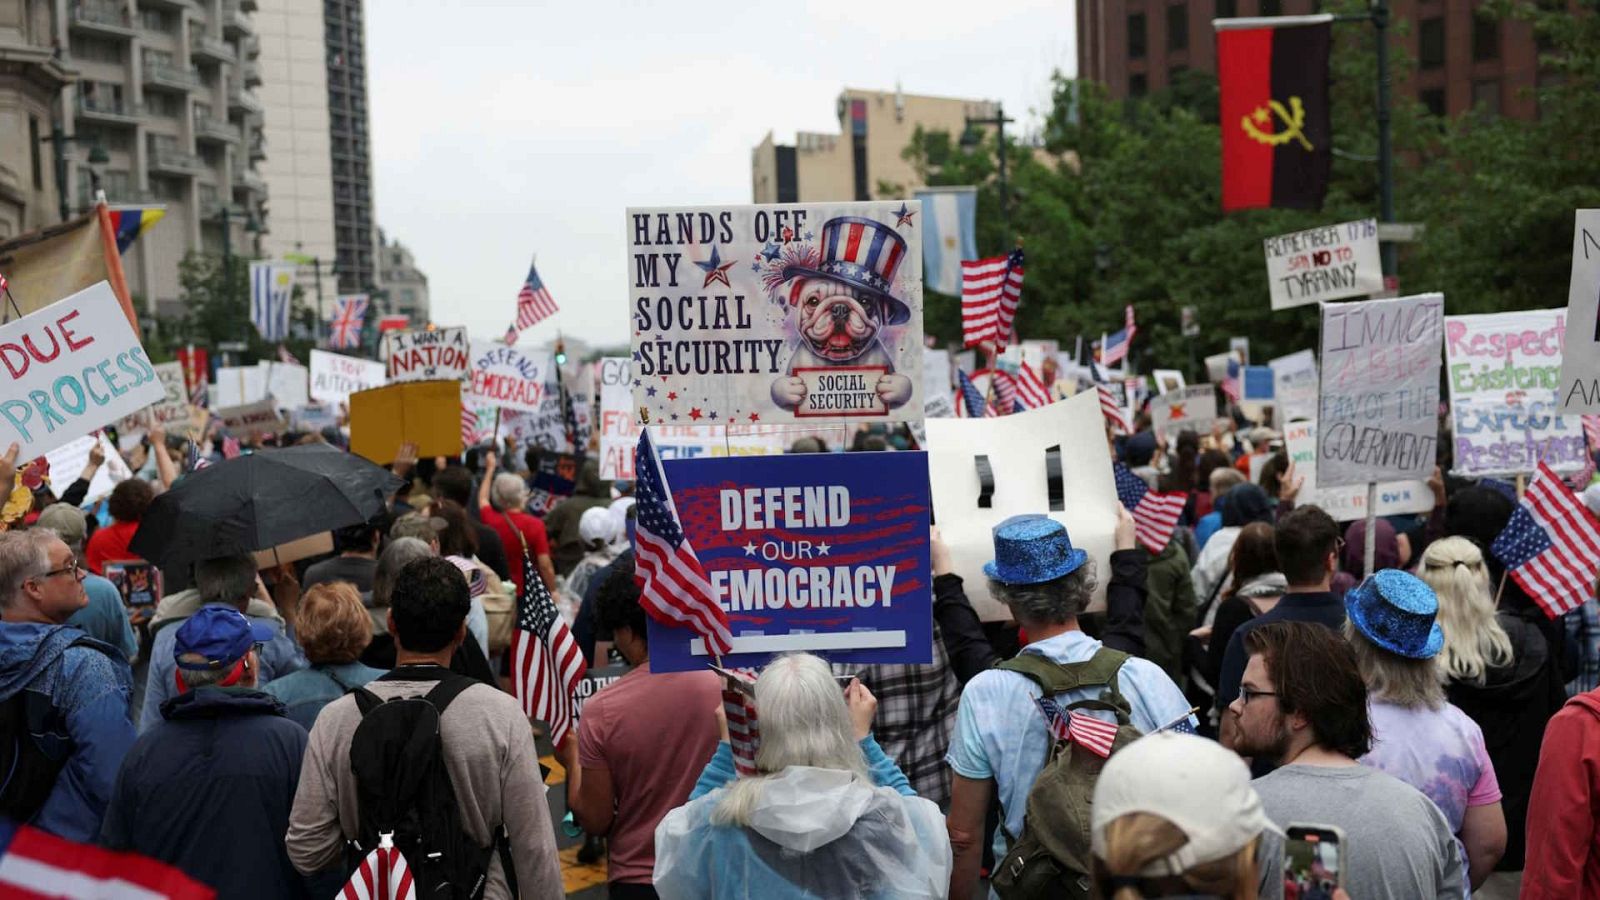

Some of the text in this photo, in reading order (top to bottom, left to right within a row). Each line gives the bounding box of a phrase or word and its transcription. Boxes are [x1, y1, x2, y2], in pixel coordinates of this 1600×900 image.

[633, 210, 807, 245] HANDS OFF
[1267, 228, 1341, 258] REMEMBER
[634, 253, 682, 288] MY
[1312, 250, 1331, 267] NO
[1334, 246, 1353, 262] TO
[1280, 263, 1357, 299] TYRANNY
[637, 295, 751, 331] SOCIAL
[1388, 302, 1441, 343] NOT
[0, 309, 95, 381] DUE
[393, 330, 465, 351] I WANT A
[1446, 315, 1565, 364] Respect
[392, 346, 468, 377] NATION
[478, 348, 538, 380] DEFEND
[641, 339, 783, 376] SECURITY
[0, 346, 155, 443] PROCESS
[818, 373, 867, 392] SOCIAL
[1451, 363, 1561, 393] Existenc
[809, 392, 876, 410] SECURITY
[1395, 386, 1437, 420] THE
[1323, 421, 1437, 471] GOVERNMENT
[720, 485, 850, 531] DEFEND
[762, 541, 813, 561] OUR
[710, 565, 896, 612] EMOCRACY
